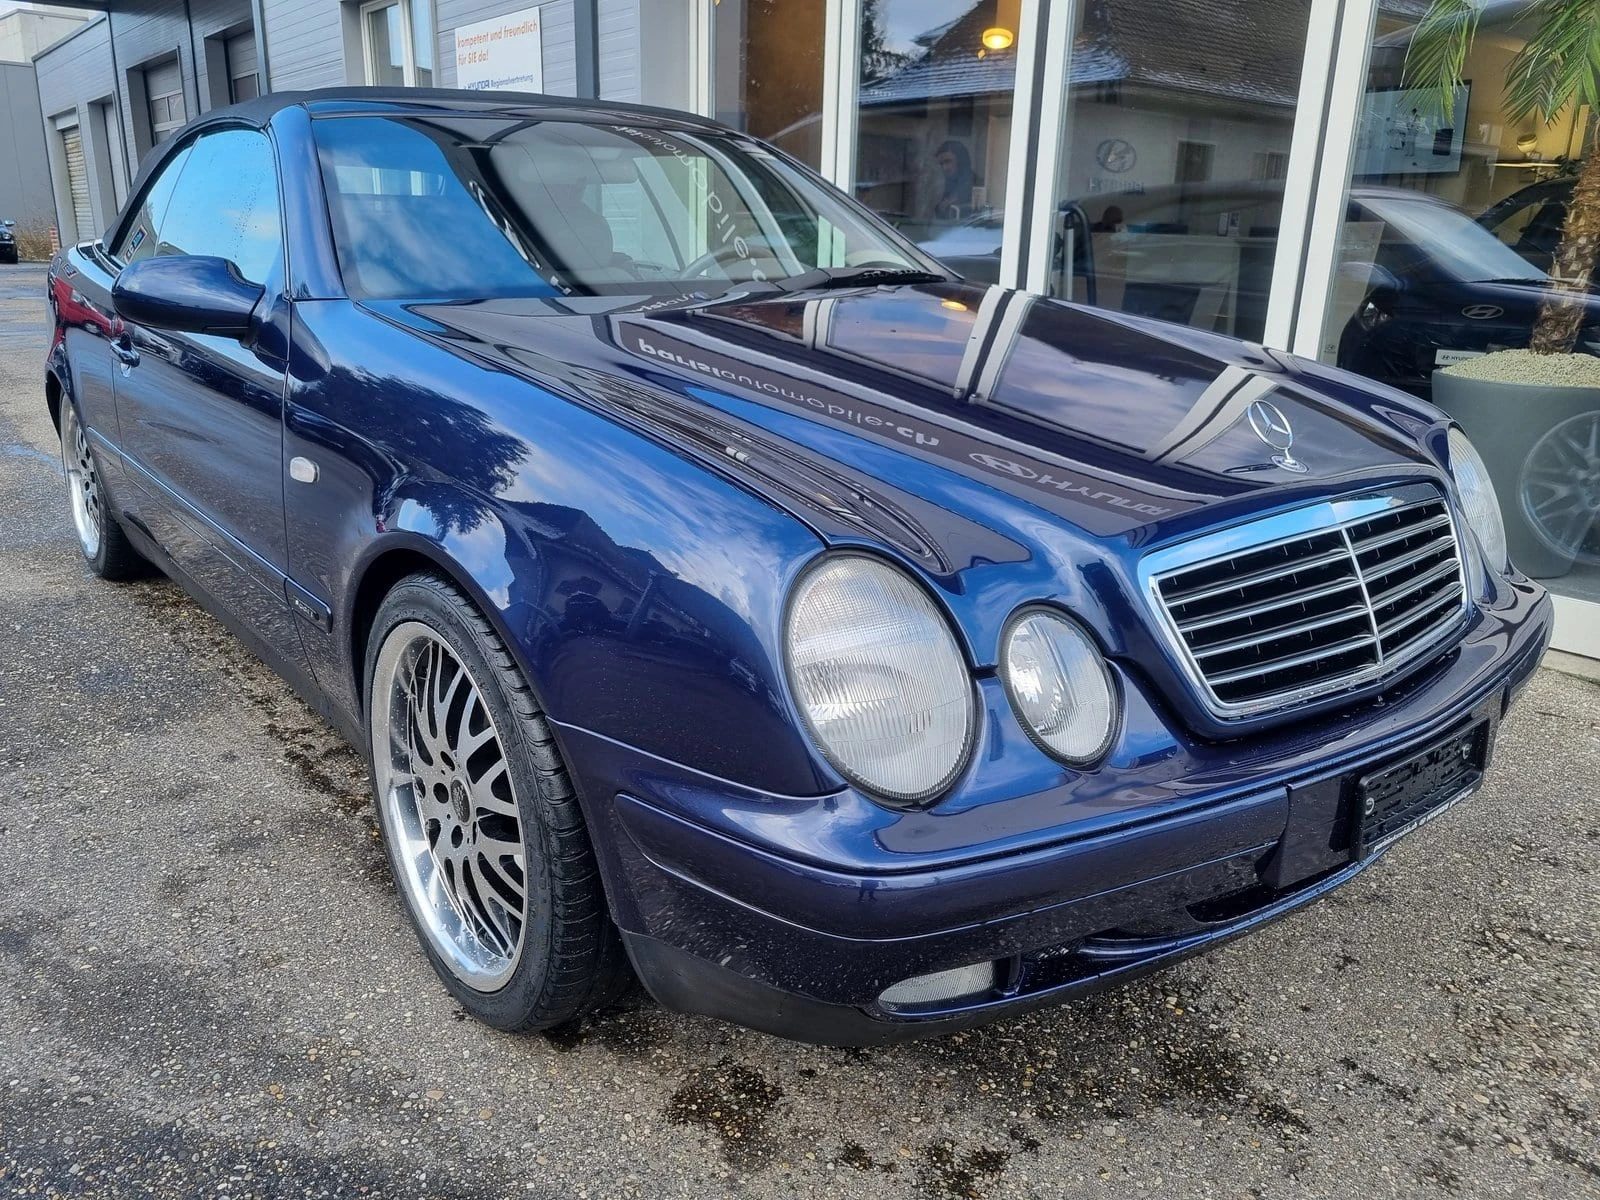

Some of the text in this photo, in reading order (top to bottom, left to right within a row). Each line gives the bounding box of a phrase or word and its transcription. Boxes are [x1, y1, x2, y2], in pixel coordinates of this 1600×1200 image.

[457, 20, 538, 48] kompetent und freundlich
[468, 52, 477, 64] SIE
